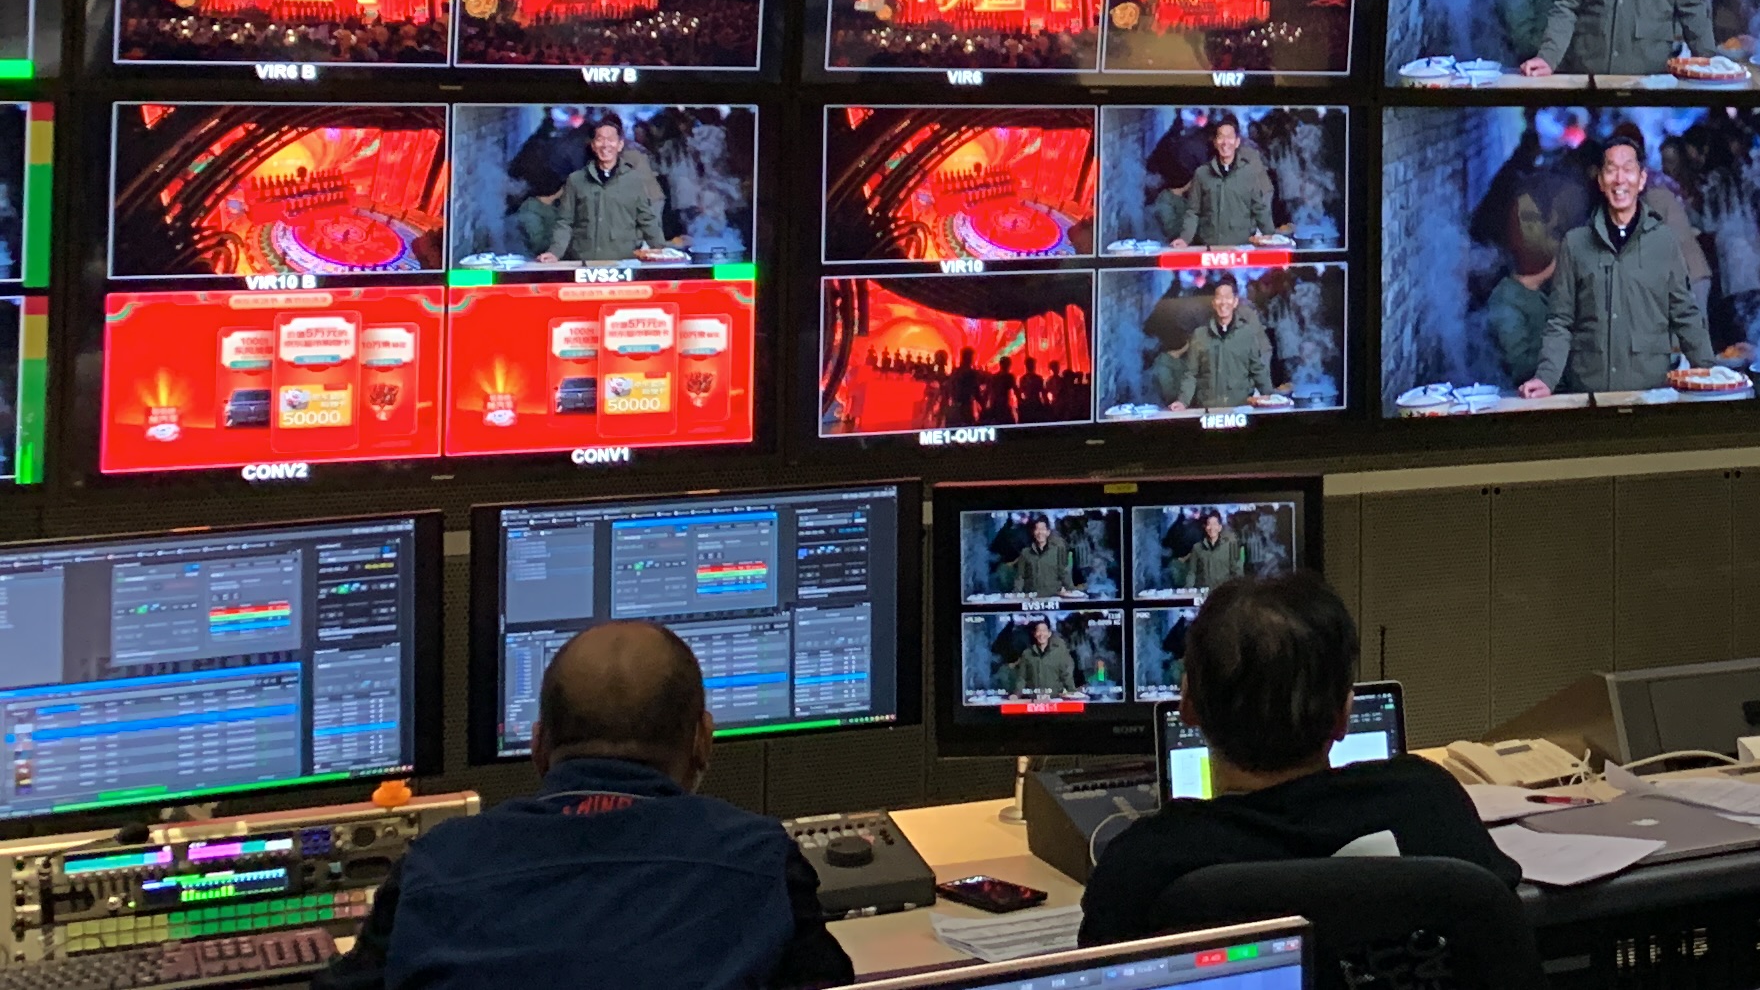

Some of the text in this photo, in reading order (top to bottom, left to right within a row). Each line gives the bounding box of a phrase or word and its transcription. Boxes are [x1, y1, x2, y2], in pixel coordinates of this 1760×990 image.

[255, 64, 298, 80] VIR6
[582, 67, 621, 84] VIR7
[947, 70, 982, 85] VIR6
[1212, 72, 1245, 87] VIR7
[940, 259, 984, 274] VIR10
[1201, 251, 1248, 266] EVS1-1
[246, 274, 298, 290] VIR10
[575, 267, 633, 283] EVS2-1
[608, 397, 660, 411] 50000
[283, 410, 341, 426] 50000
[918, 428, 995, 445] ME1-OUT1
[571, 446, 630, 465] CONV1
[242, 461, 309, 481] CONV2
[1026, 702, 1058, 712] EVS1-1
